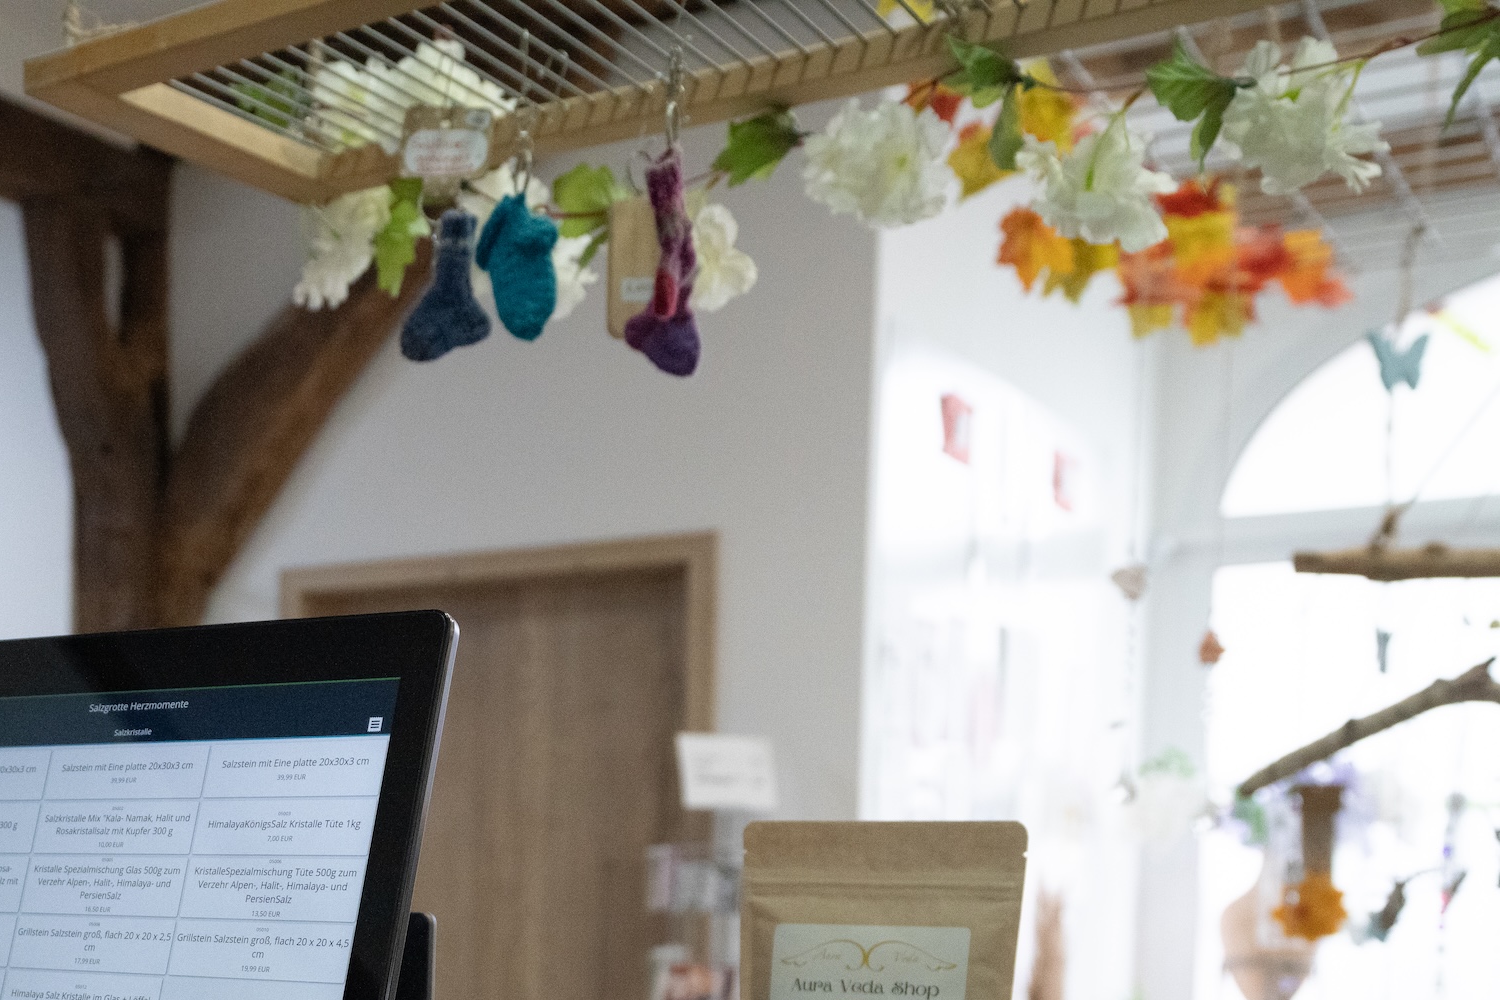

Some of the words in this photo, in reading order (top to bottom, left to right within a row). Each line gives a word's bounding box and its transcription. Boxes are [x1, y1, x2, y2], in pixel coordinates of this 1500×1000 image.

[89, 703, 128, 713] Salzgrotte
[130, 701, 189, 711] Herzmomente
[114, 728, 152, 736] Salzkristalle
[62, 764, 93, 772] Salzstein
[95, 763, 107, 771] mit
[108, 763, 123, 771] Eine
[125, 763, 147, 772] platte
[148, 762, 180, 770] 20x30x3
[222, 760, 256, 768] Salzstein
[259, 759, 272, 768] mit
[274, 759, 291, 767] Eine
[293, 758, 317, 768] platte
[319, 757, 354, 766] 20x30x3
[126, 814, 153, 823] Namak,
[208, 819, 287, 830] HimalayaKönigsSalz
[289, 820, 322, 828] Kristalle
[325, 820, 343, 828] Tüte
[347, 820, 361, 830] 1kg
[64, 866, 123, 876] Spezialmischung
[126, 866, 141, 874] Glas
[144, 867, 162, 876] 500g
[195, 867, 293, 878] KristalleSpezialmischung
[296, 868, 313, 877] Tüte
[315, 868, 336, 879] 500g
[38, 878, 65, 886] Verzehr
[67, 878, 91, 888] Alpen-,
[94, 879, 114, 887] Halit-,
[117, 880, 154, 889] Himalaya-
[198, 881, 228, 889] Verzehr
[230, 881, 258, 892] Alpen-,
[261, 882, 284, 891] Halit-,
[287, 882, 328, 893] Himalaya-
[331, 882, 348, 891] und
[80, 892, 121, 900] PersienSalz
[245, 895, 292, 903] PersienSalz
[18, 928, 49, 936] Grillstein
[50, 929, 82, 938] Salzstein
[83, 930, 102, 940] groß,
[104, 931, 122, 939] flach
[124, 932, 134, 940] 20
[159, 933, 171, 941] 2,5
[177, 933, 212, 943] Grillstein
[214, 935, 249, 944] Salzstein
[251, 936, 272, 947] groß,
[275, 936, 294, 946] flach
[297, 938, 307, 946] 20
[316, 938, 327, 947] 20
[336, 939, 349, 948] 4,5
[791, 977, 832, 992] Aura
[840, 979, 884, 994] Veda
[891, 982, 939, 1000] Shop
[11, 990, 44, 1000] Himalaya
[45, 992, 60, 1000] Salz
